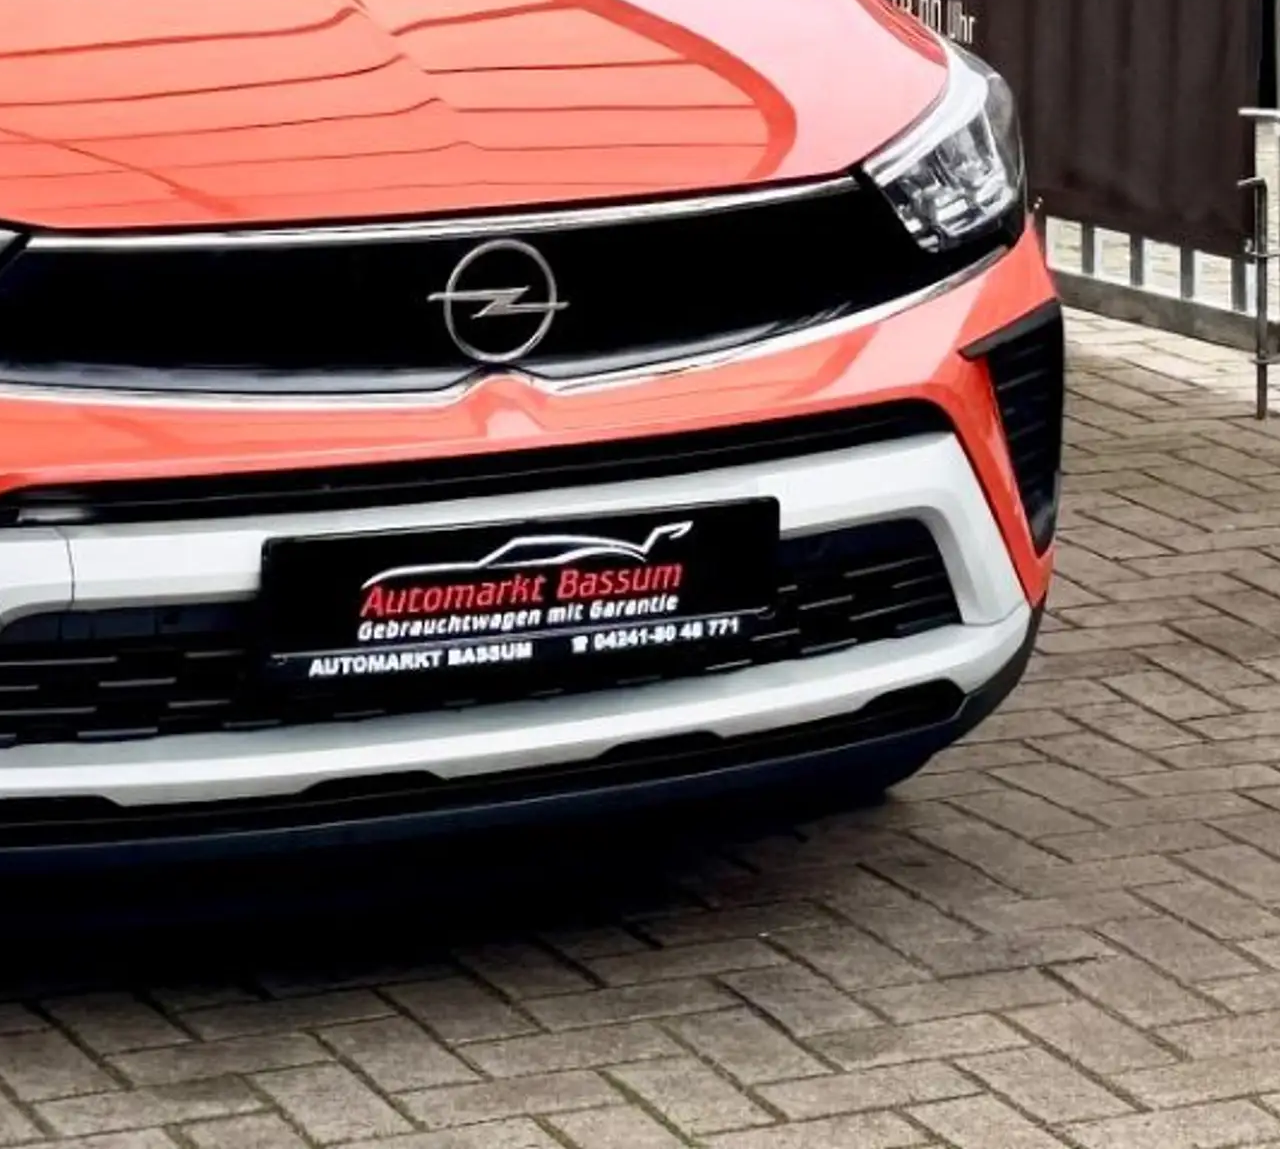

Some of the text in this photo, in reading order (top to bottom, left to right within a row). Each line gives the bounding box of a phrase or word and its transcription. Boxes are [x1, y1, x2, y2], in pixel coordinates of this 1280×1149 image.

[360, 563, 684, 616] Automarkt Bassum
[357, 594, 679, 641] Gebrauchtwagen mit Garantie
[308, 651, 441, 677] AUTOMARKT
[447, 643, 533, 667] BASSUM
[707, 616, 739, 636] 771
